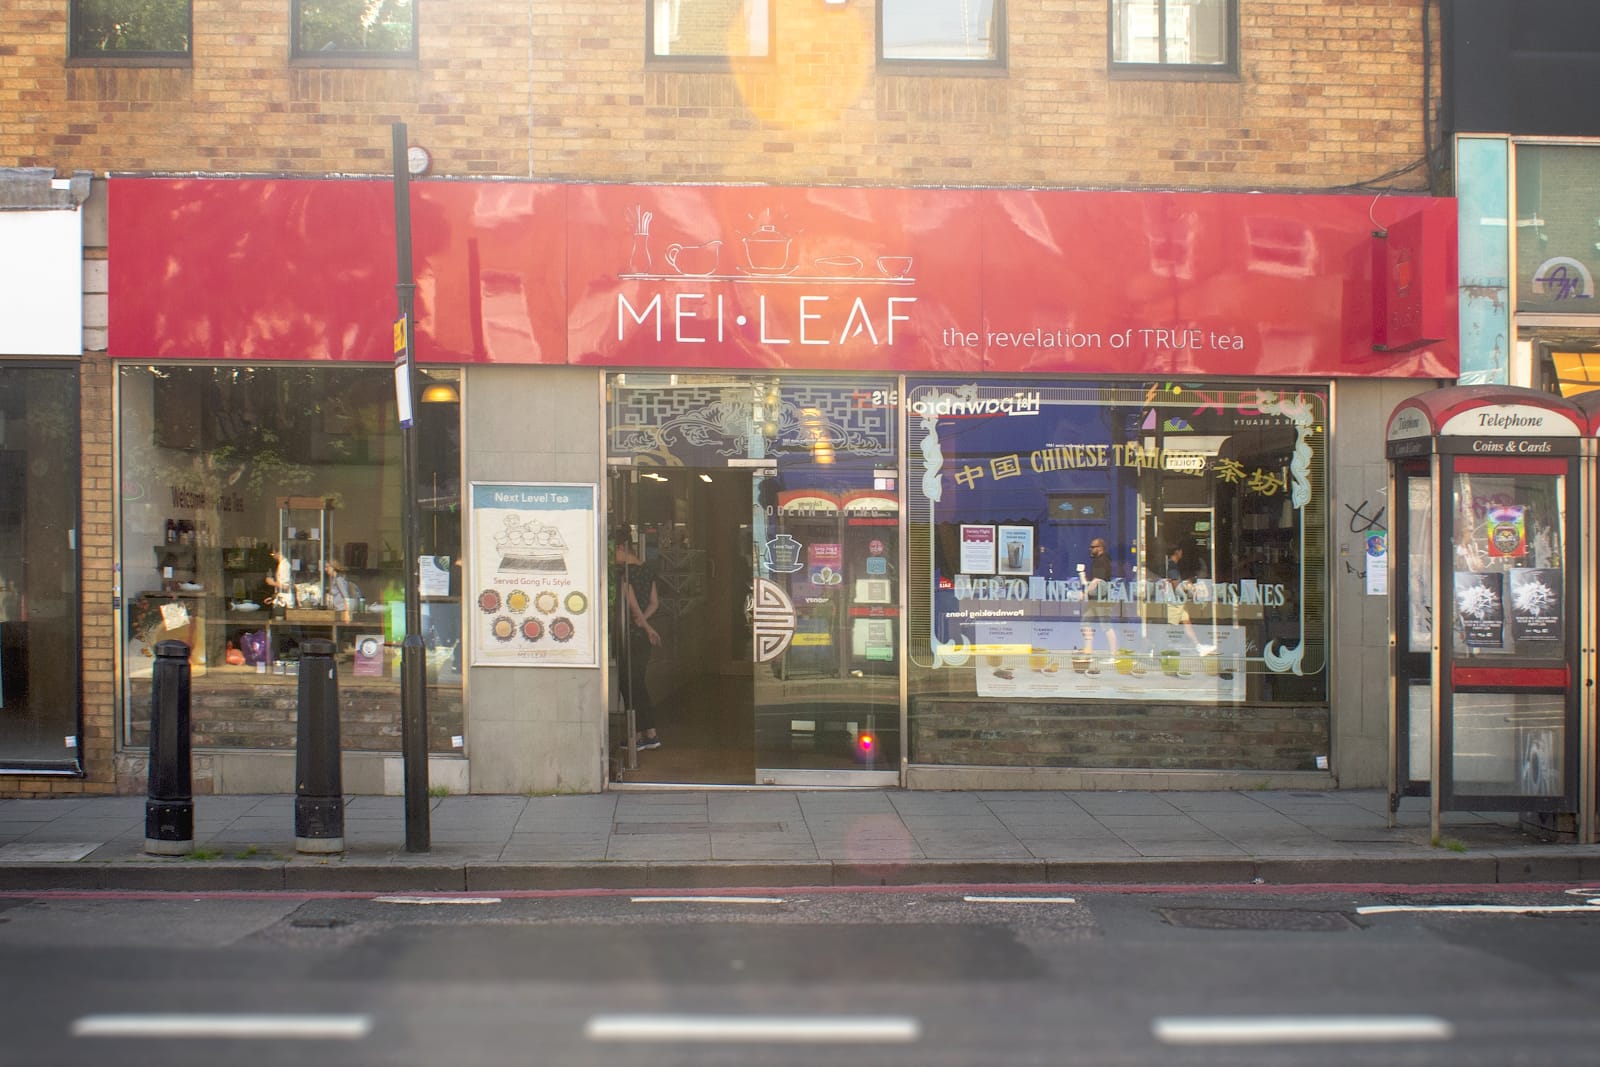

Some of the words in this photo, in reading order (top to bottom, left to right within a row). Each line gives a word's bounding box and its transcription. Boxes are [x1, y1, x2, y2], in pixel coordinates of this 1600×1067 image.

[942, 327, 979, 347] the
[986, 328, 1102, 348] revelation
[1108, 329, 1133, 349] of
[1138, 329, 1203, 350] TRUE
[1209, 331, 1245, 351] tea
[1478, 412, 1544, 430] Telephone
[1472, 440, 1504, 453] Coins
[1505, 440, 1518, 453] &
[1518, 441, 1552, 453] Cards
[1030, 444, 1109, 474] CHINESE
[1111, 443, 1208, 477] TEAHOE
[953, 453, 1022, 491] 中国
[494, 492, 519, 503] Next
[521, 492, 548, 504] Level
[550, 493, 569, 504] Tea
[766, 505, 817, 517] ODERN
[493, 577, 520, 586] Served
[520, 577, 541, 587] Gong
[542, 578, 551, 586] Fu
[552, 578, 572, 587] Style
[953, 578, 1001, 602] OVER
[1003, 578, 1028, 602] 70
